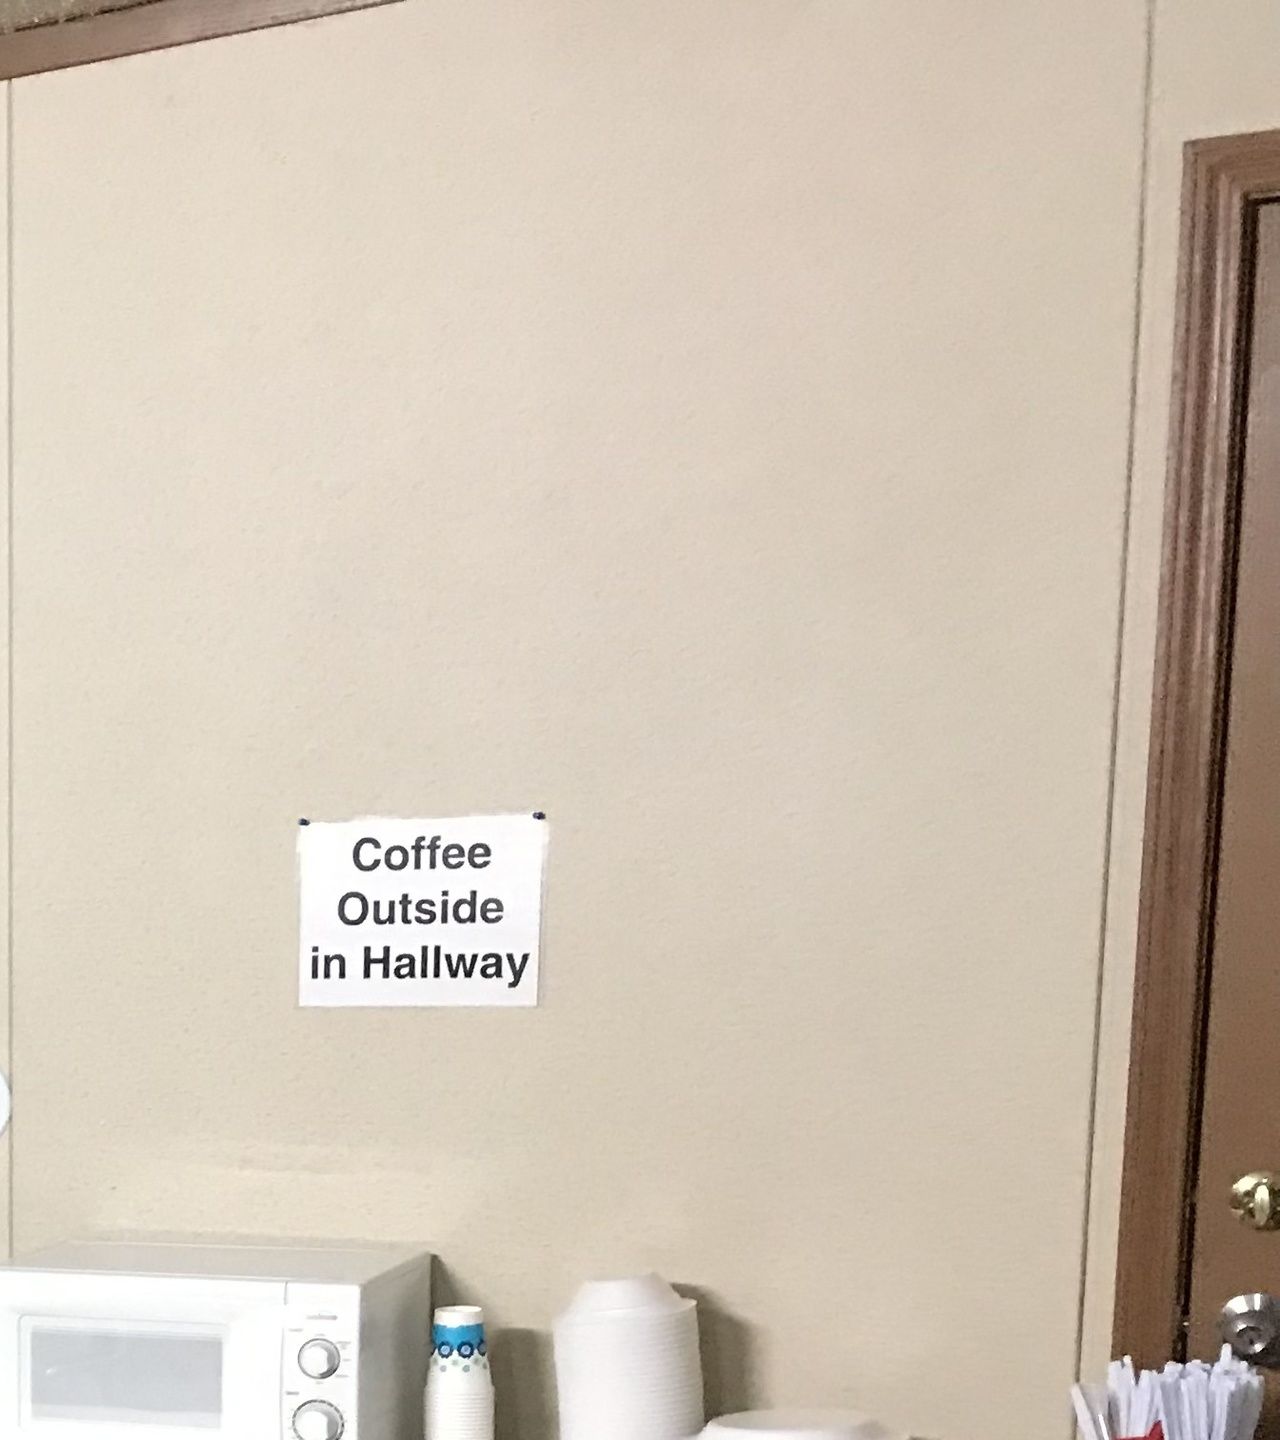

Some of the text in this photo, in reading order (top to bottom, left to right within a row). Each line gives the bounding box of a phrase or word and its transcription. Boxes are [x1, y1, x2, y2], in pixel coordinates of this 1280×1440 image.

[352, 835, 492, 872] Coffee
[337, 890, 504, 926] Outside
[311, 945, 530, 989] in Hallway
